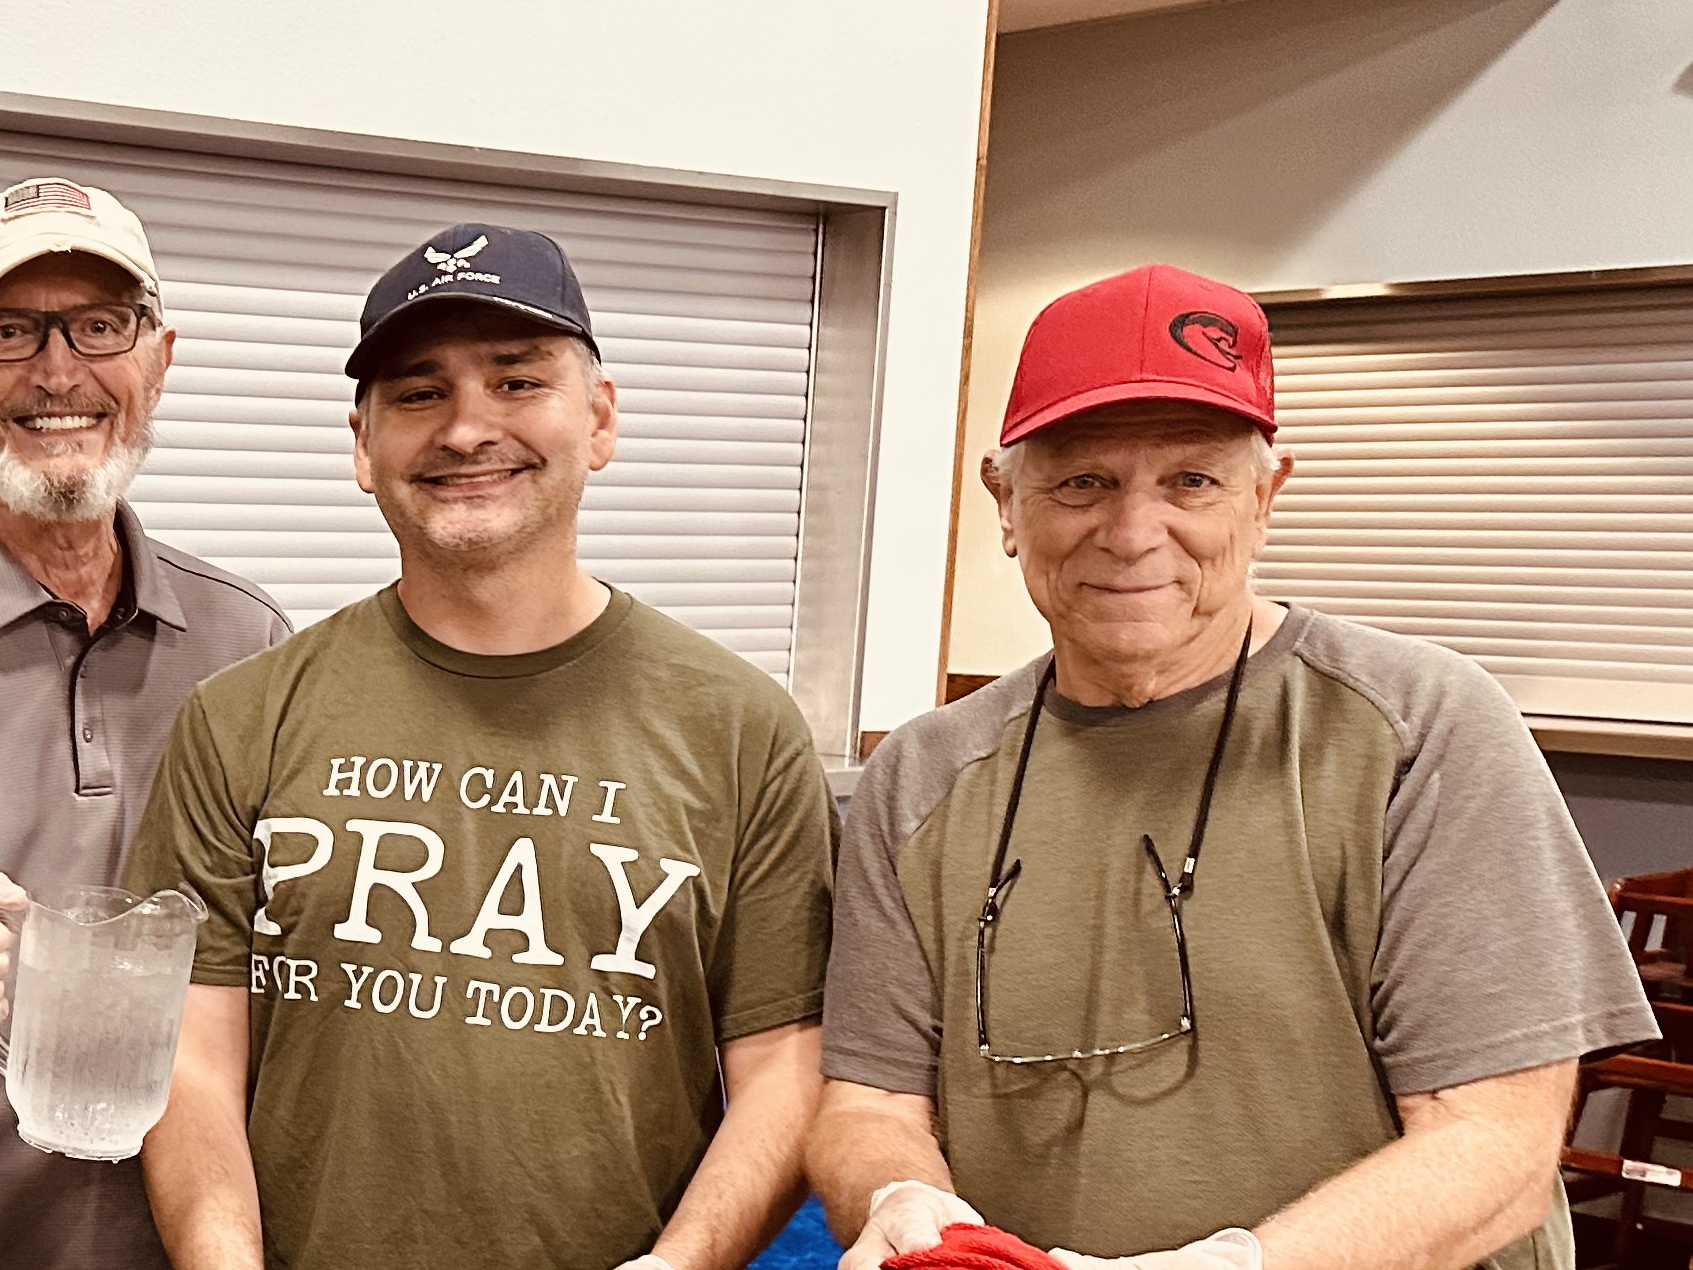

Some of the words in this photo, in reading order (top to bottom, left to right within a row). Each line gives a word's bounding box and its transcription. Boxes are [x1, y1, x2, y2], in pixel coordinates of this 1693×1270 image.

[408, 284, 429, 301] U.S.
[431, 274, 454, 287] AIR
[457, 272, 500, 285] FORCE
[323, 756, 443, 803] HOW
[460, 766, 578, 817] CAN
[592, 780, 627, 824] I
[253, 817, 701, 979] PRAY
[341, 963, 448, 1019] YOU
[465, 979, 663, 1041] TODAY?
